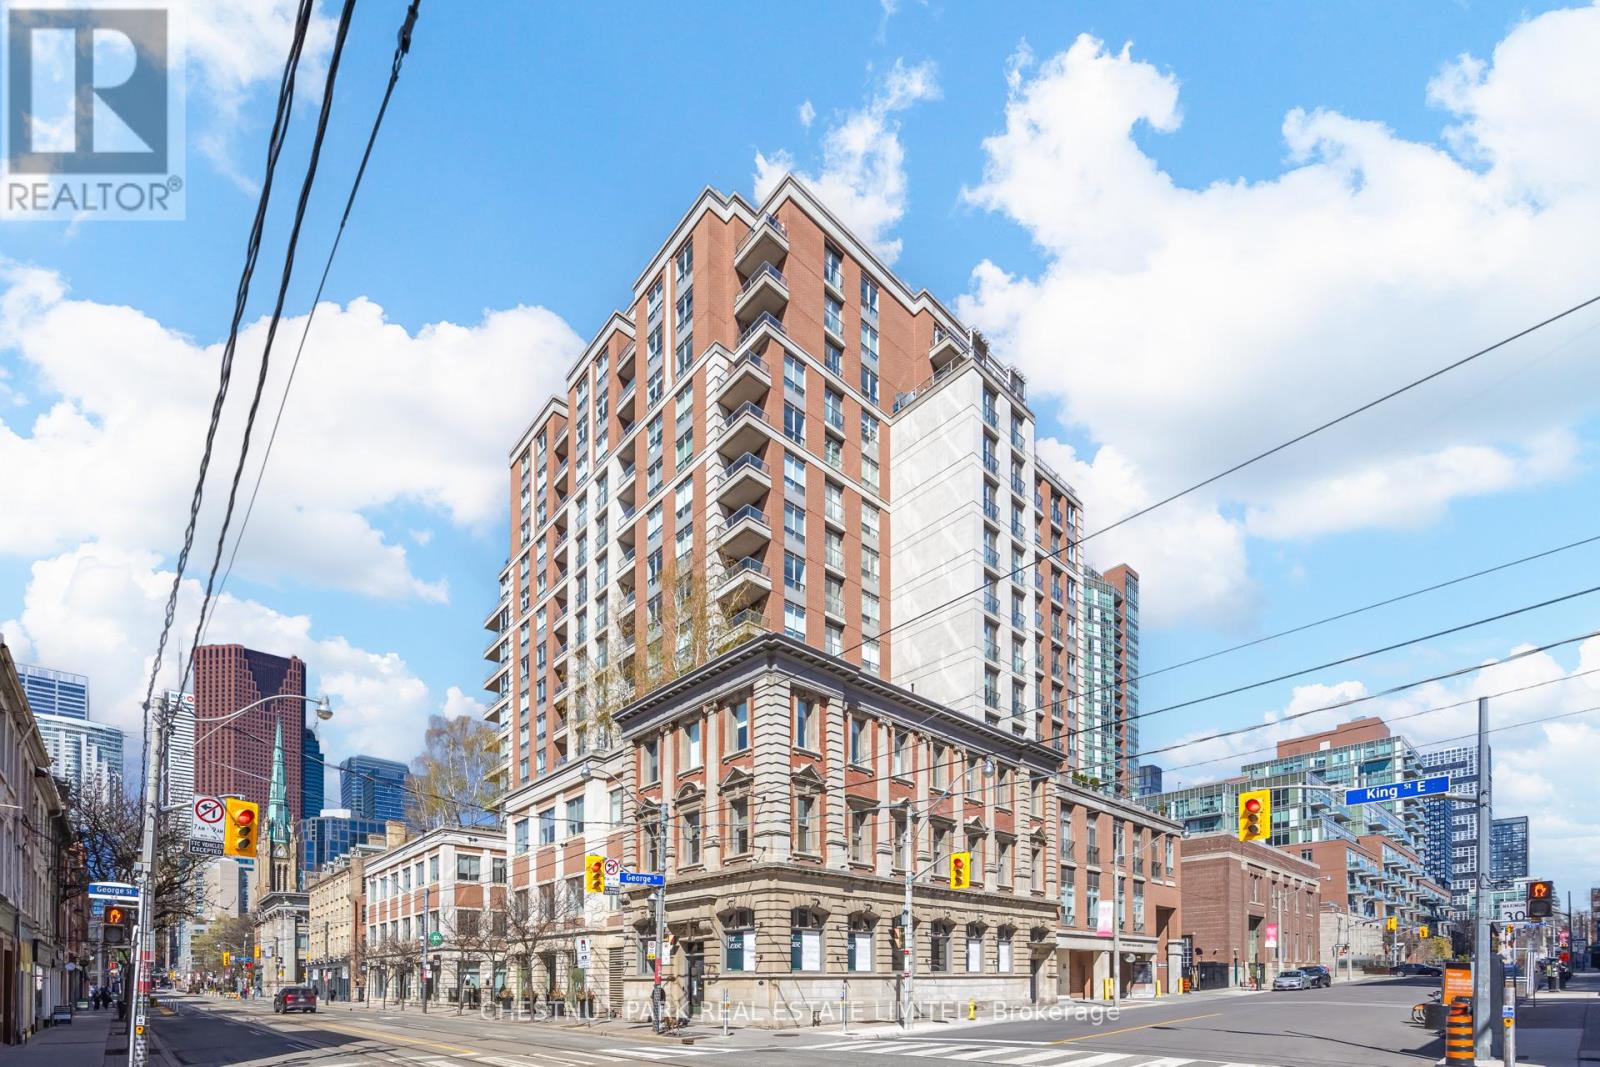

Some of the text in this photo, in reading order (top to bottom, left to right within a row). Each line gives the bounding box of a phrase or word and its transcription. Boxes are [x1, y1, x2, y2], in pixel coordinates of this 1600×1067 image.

[1366, 787, 1398, 799] King
[1417, 781, 1426, 792] E
[191, 846, 222, 855] EXCEPTED
[202, 842, 224, 850] VEHICLES
[626, 873, 652, 884] George
[96, 885, 125, 895] George
[1504, 911, 1526, 921] 30
